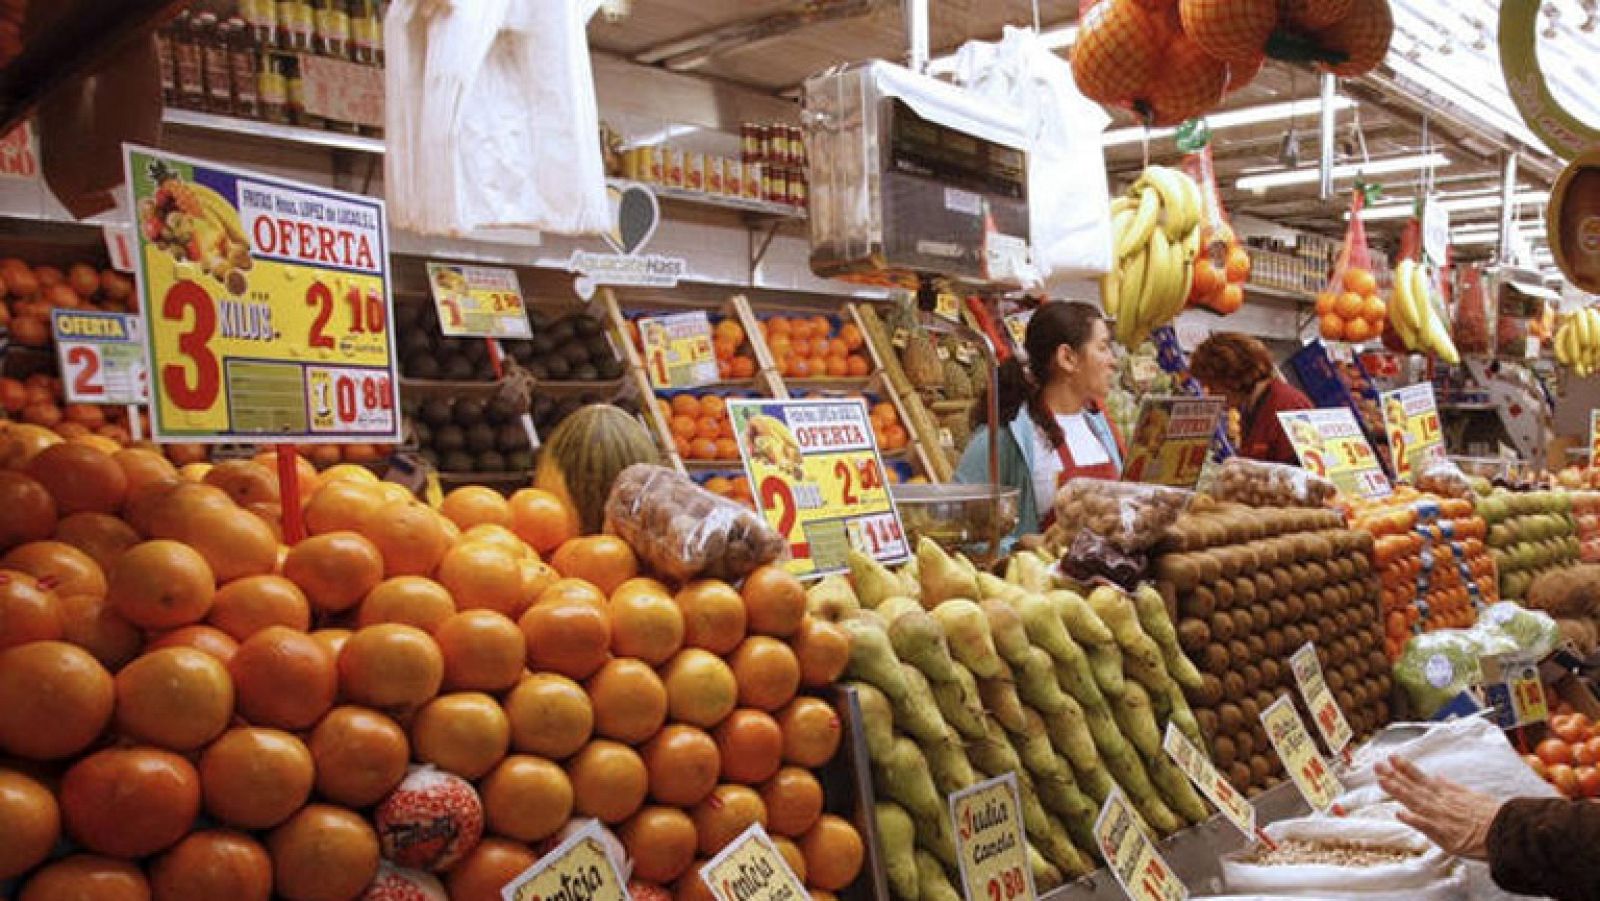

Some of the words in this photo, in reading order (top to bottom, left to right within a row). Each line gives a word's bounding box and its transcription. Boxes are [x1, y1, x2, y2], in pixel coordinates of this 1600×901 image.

[253, 214, 376, 269] OFERTA
[57, 314, 126, 339] OFERTA
[161, 279, 221, 413] 3
[67, 346, 105, 395] 2
[795, 424, 865, 448] OFERTA
[761, 475, 811, 559] 2
[531, 865, 603, 901] teja
